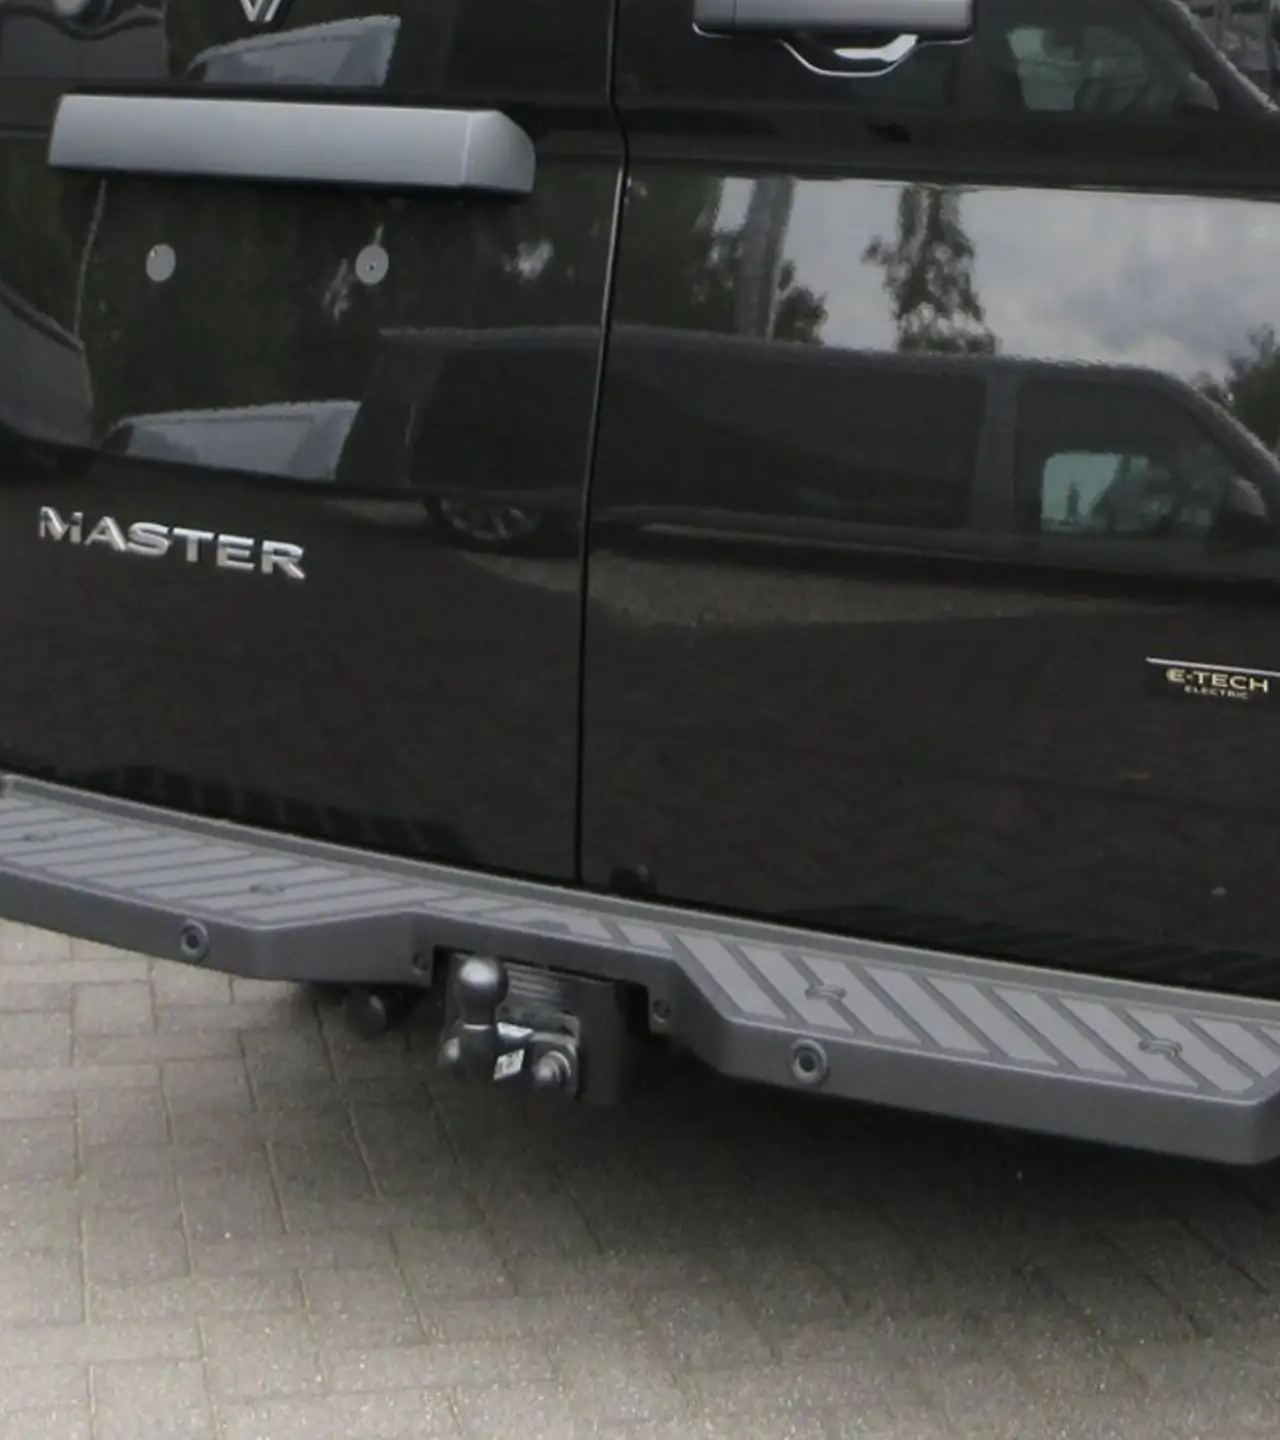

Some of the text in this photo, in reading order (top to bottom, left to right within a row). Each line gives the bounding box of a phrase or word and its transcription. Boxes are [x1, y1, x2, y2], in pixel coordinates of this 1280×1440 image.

[38, 505, 306, 580] MASTER
[1166, 668, 1269, 693] E-TECH
[1184, 684, 1249, 700] ELECTRIC
